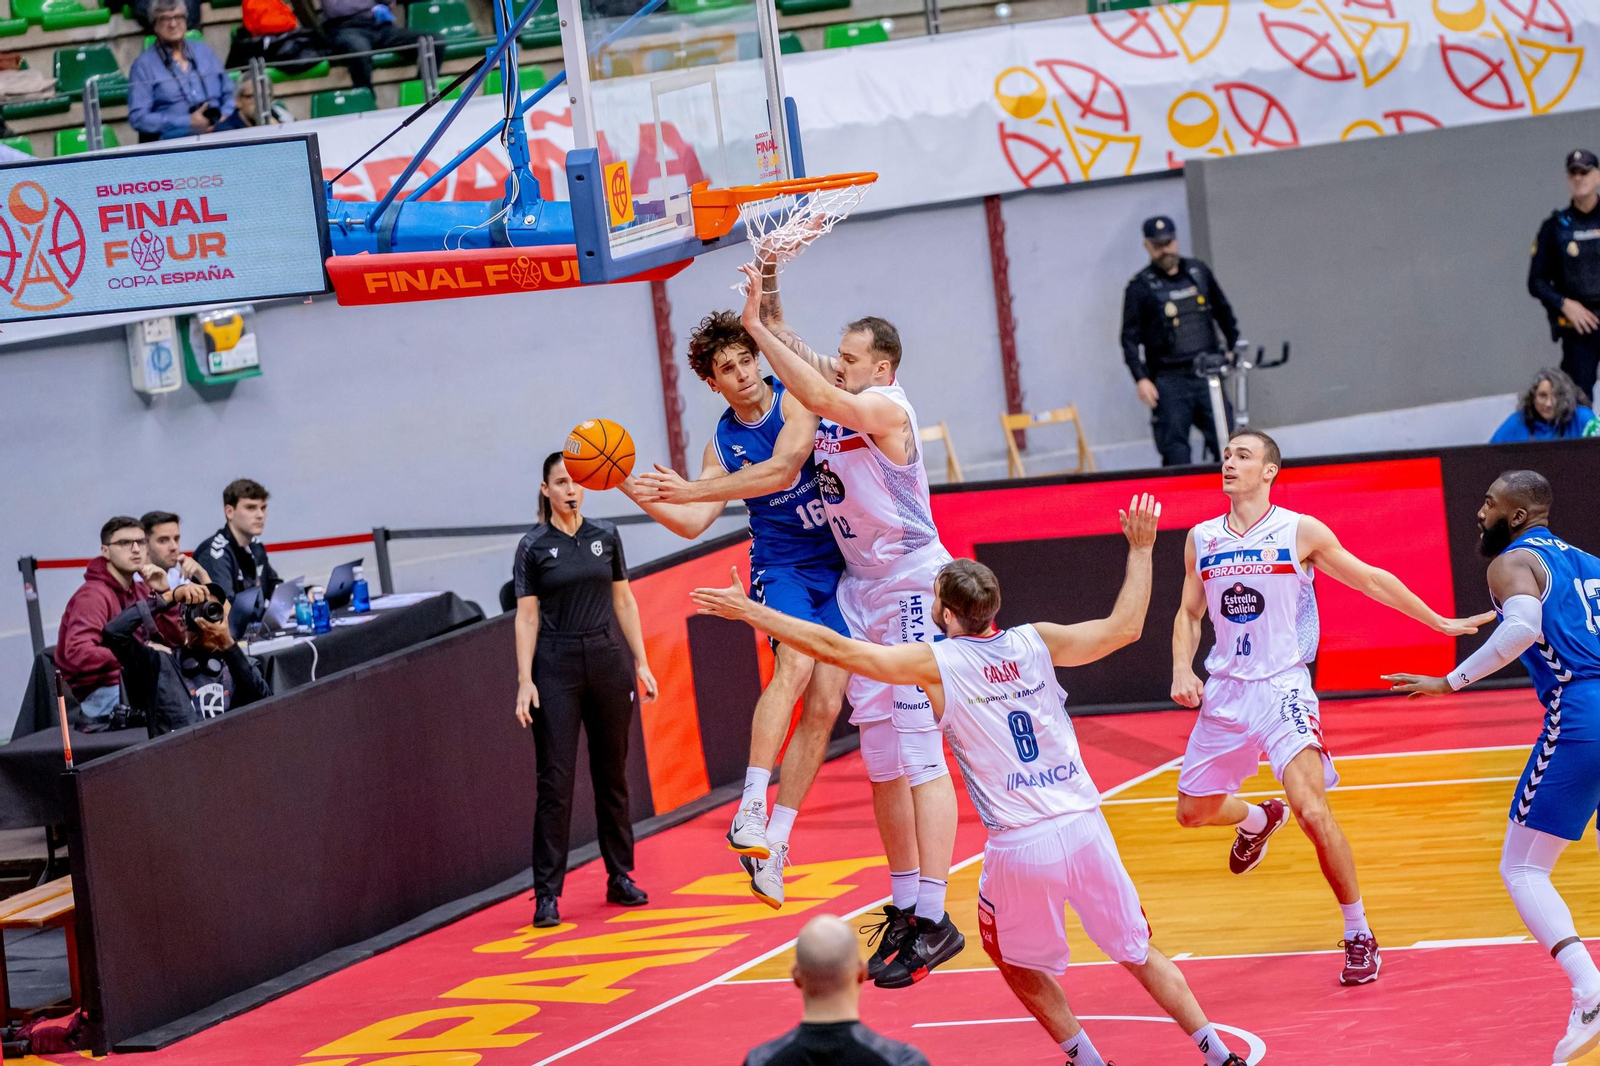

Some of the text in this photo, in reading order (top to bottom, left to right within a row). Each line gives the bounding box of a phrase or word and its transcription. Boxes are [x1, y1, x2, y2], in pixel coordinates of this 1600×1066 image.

[755, 138, 778, 154] FINAL
[97, 196, 228, 233] FINAL
[108, 265, 235, 290] COPA ESPAÑA
[363, 258, 581, 294] FINAL FOU
[769, 476, 820, 507] GRUPO HERED
[796, 499, 828, 530] 16
[1208, 564, 1273, 579] OBRADOIRO
[1224, 593, 1257, 605] Estrella
[1227, 603, 1256, 615] Galicia
[910, 595, 925, 629] HEY,
[1235, 633, 1252, 656] 16
[983, 660, 1021, 683] GALÁN
[1007, 710, 1040, 763] 8
